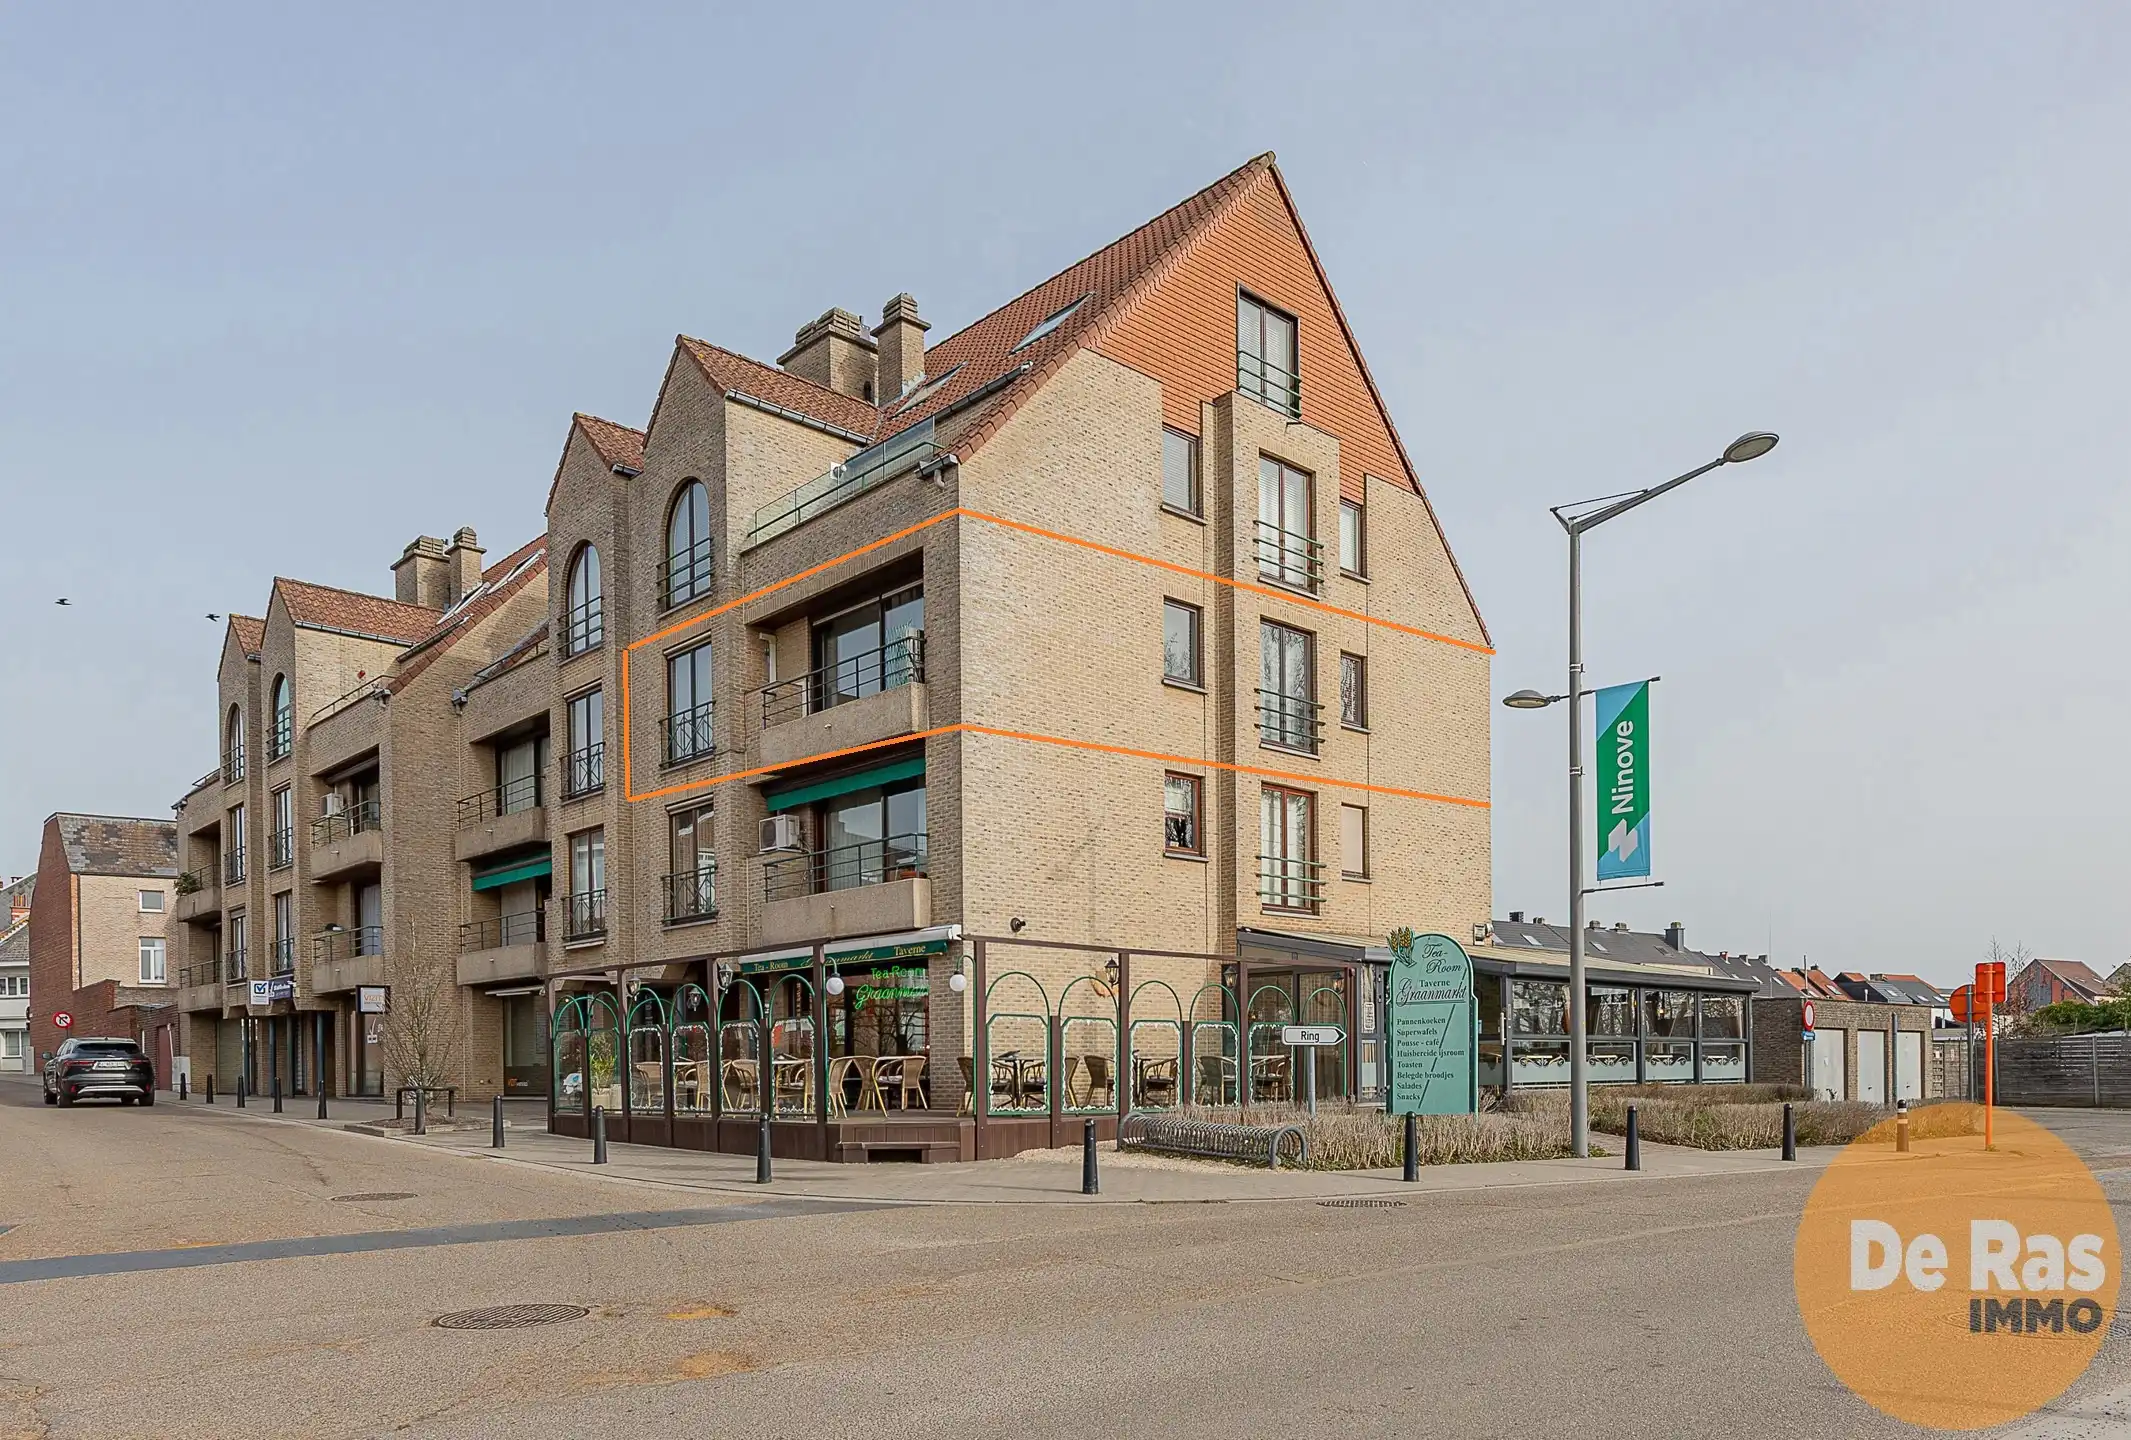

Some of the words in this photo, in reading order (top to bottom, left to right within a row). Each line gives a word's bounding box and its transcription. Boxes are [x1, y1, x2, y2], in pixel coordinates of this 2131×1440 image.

[1612, 720, 1634, 814] Ninove
[1422, 943, 1448, 958] Tea-
[754, 963, 765, 972] Tea
[770, 961, 789, 971] Room
[801, 951, 874, 967] Ganmarkt
[895, 945, 926, 956] Taverne
[1426, 959, 1461, 974] Room
[1420, 980, 1451, 988] Taverne
[1396, 977, 1467, 1007] Graanmarkt
[1397, 1016, 1446, 1025] Pannenkoeken
[1301, 1031, 1320, 1043] Ring
[1397, 1028, 1438, 1037] Superwafels
[1397, 1050, 1437, 1058] Huisbereide
[1438, 1049, 1465, 1059] ijsroom
[1397, 1061, 1423, 1069] Toasten
[1397, 1071, 1423, 1080] Belegde
[1424, 1071, 1455, 1081] broodjes
[1396, 1082, 1423, 1090] Salades
[1396, 1093, 1421, 1101] Snacks
